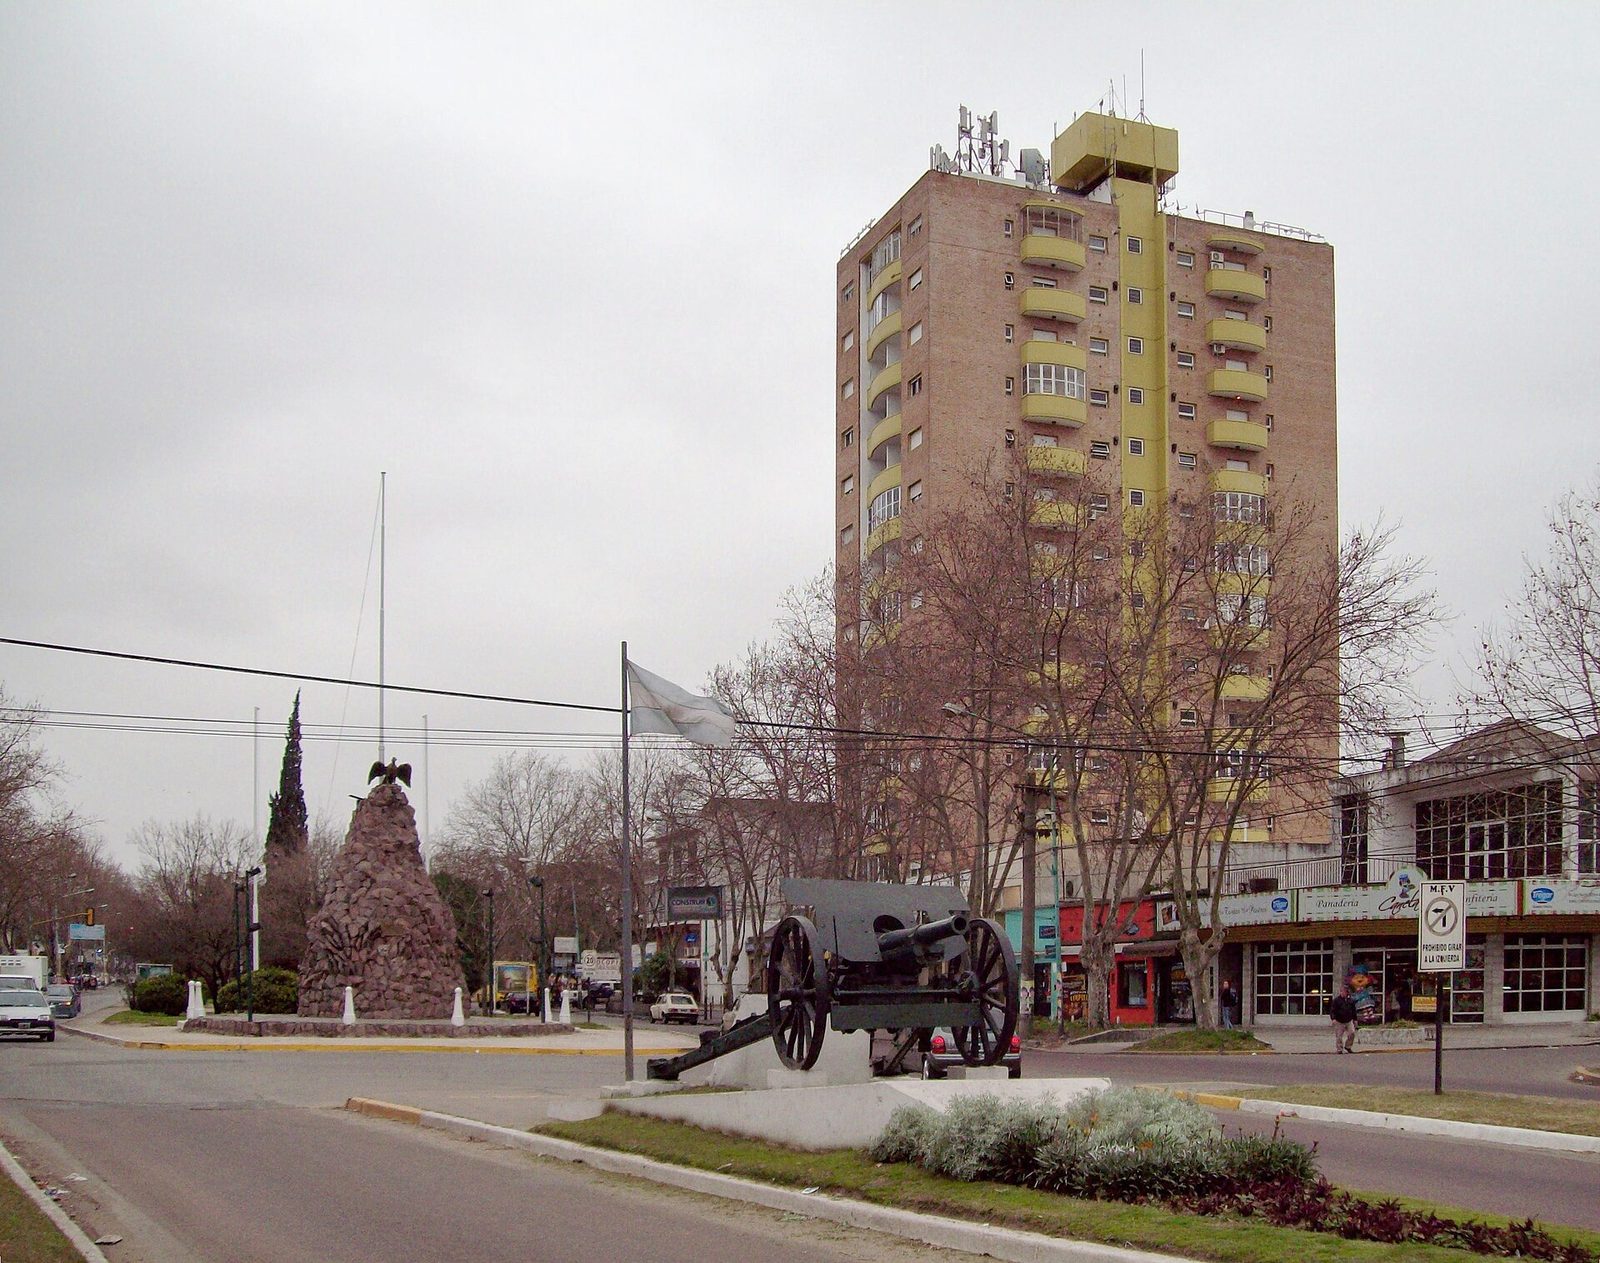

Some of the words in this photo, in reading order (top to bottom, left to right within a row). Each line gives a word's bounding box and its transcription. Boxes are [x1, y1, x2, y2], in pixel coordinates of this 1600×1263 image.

[1422, 943, 1447, 952] PROHIBIDO
[1447, 943, 1462, 952] GIRAR
[1428, 955, 1435, 963] LA
